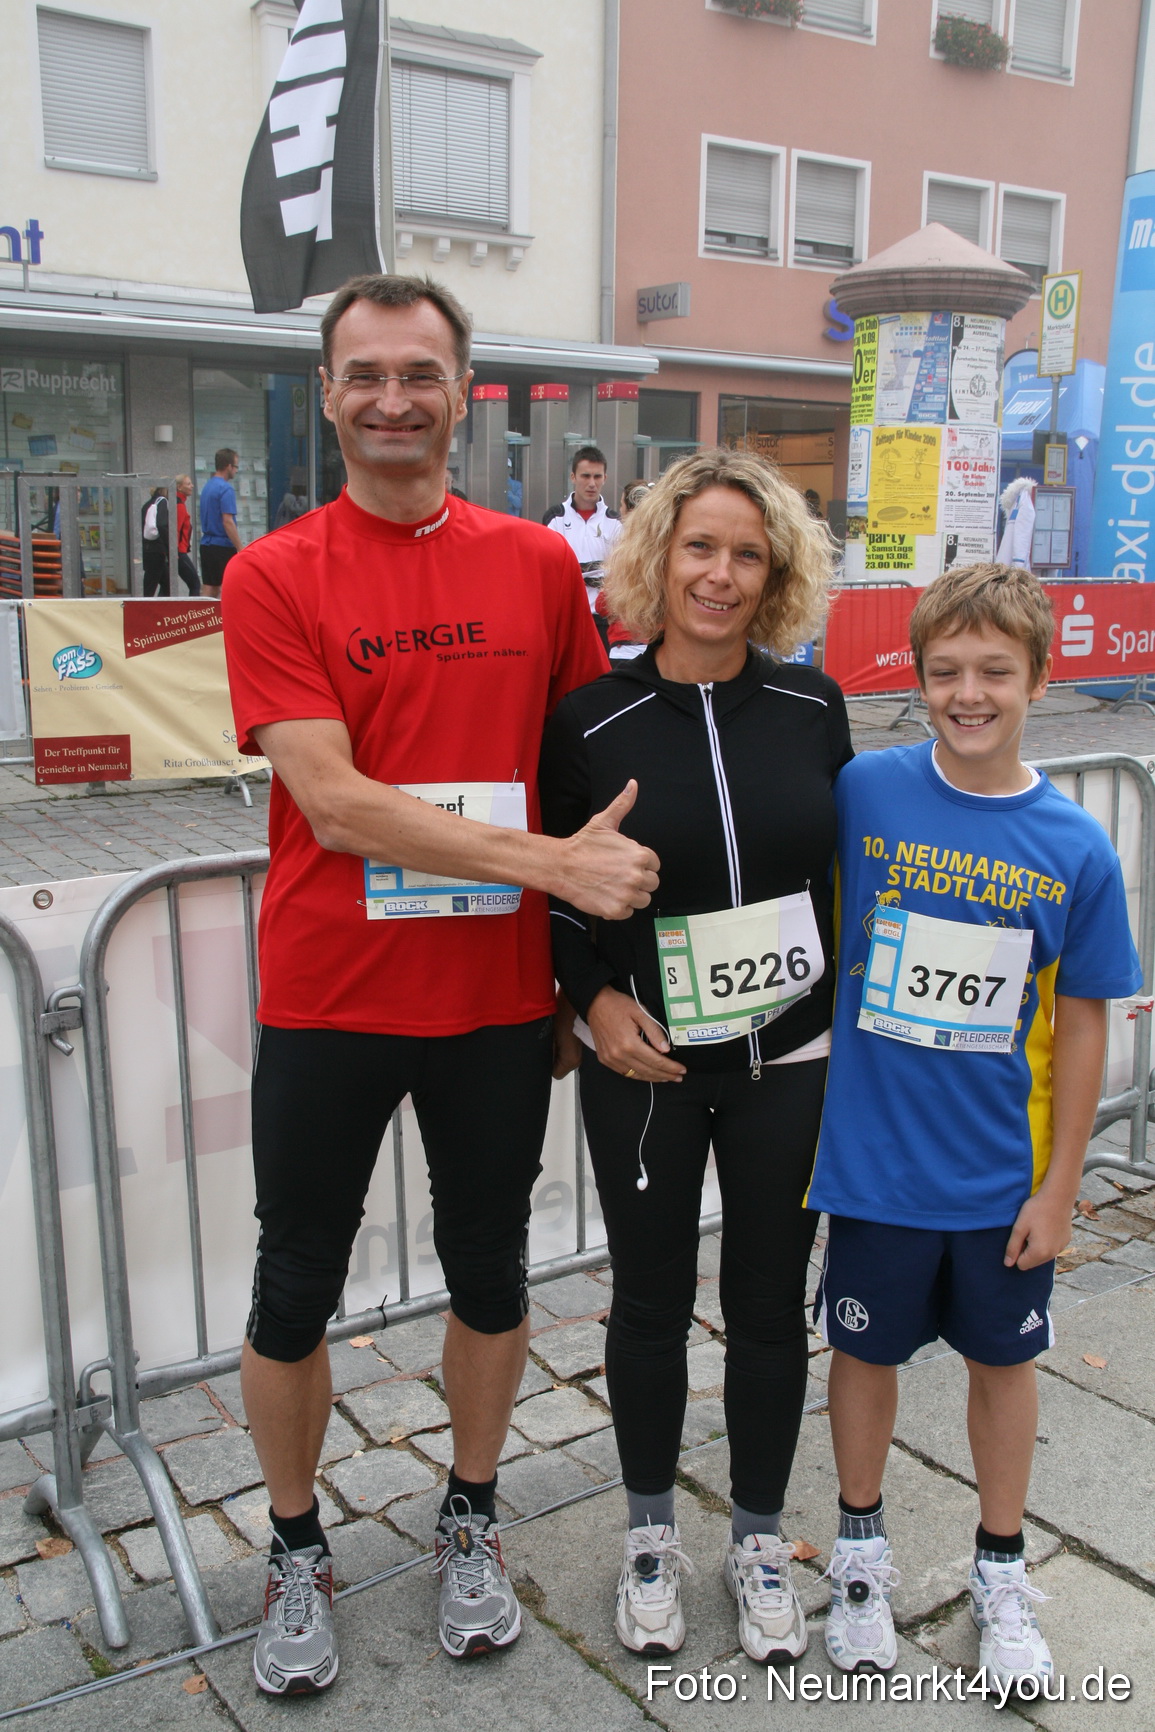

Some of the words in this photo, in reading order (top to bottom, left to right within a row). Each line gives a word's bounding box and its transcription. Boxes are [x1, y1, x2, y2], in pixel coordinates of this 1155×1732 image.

[1054, 288, 1069, 312] H
[953, 316, 964, 328] 8.
[1047, 323, 1071, 331] Marktplatz
[27, 369, 117, 396] Rupprecht
[1006, 397, 1050, 415] maxi
[1018, 413, 1041, 426] dsl
[904, 428, 922, 441] Kinder
[923, 434, 937, 447] 2009
[946, 460, 970, 471] 100
[973, 461, 996, 473] Jahre
[947, 534, 957, 546] 8.
[871, 545, 913, 553] Samstags
[886, 552, 911, 560] 13.08.
[865, 561, 890, 569] 23.00
[893, 561, 914, 569] Uhr
[163, 606, 215, 627] Partyfässer
[133, 627, 187, 648] Spirituosen
[188, 621, 206, 632] aus
[1106, 623, 1155, 662] Spar
[56, 649, 76, 665] vom
[436, 651, 489, 663] Spürbar
[493, 649, 530, 658] näher.
[58, 651, 97, 681] FASS
[59, 684, 90, 692] Probieren
[44, 748, 60, 758] Der
[62, 746, 106, 757] Treffpunkt
[108, 745, 120, 754] für
[37, 764, 76, 774] Genießer
[77, 763, 86, 772] in
[88, 762, 128, 772] Neumarkt
[163, 759, 183, 768] Rita
[185, 757, 235, 768] Großhauser
[862, 836, 890, 861] 10.
[895, 841, 1067, 905] NEUMARKTER
[886, 864, 1032, 912] STADTLAUF
[384, 901, 428, 912] BOCK
[470, 893, 521, 906] PFLEIDERER
[667, 967, 678, 985] S
[710, 946, 811, 998] 5226
[907, 965, 1006, 1007] 3767
[687, 1025, 729, 1039] BOCK
[873, 1018, 912, 1035] BOCK
[952, 1031, 1010, 1043] PFLEIDERER
[1019, 1318, 1044, 1335] adidas
